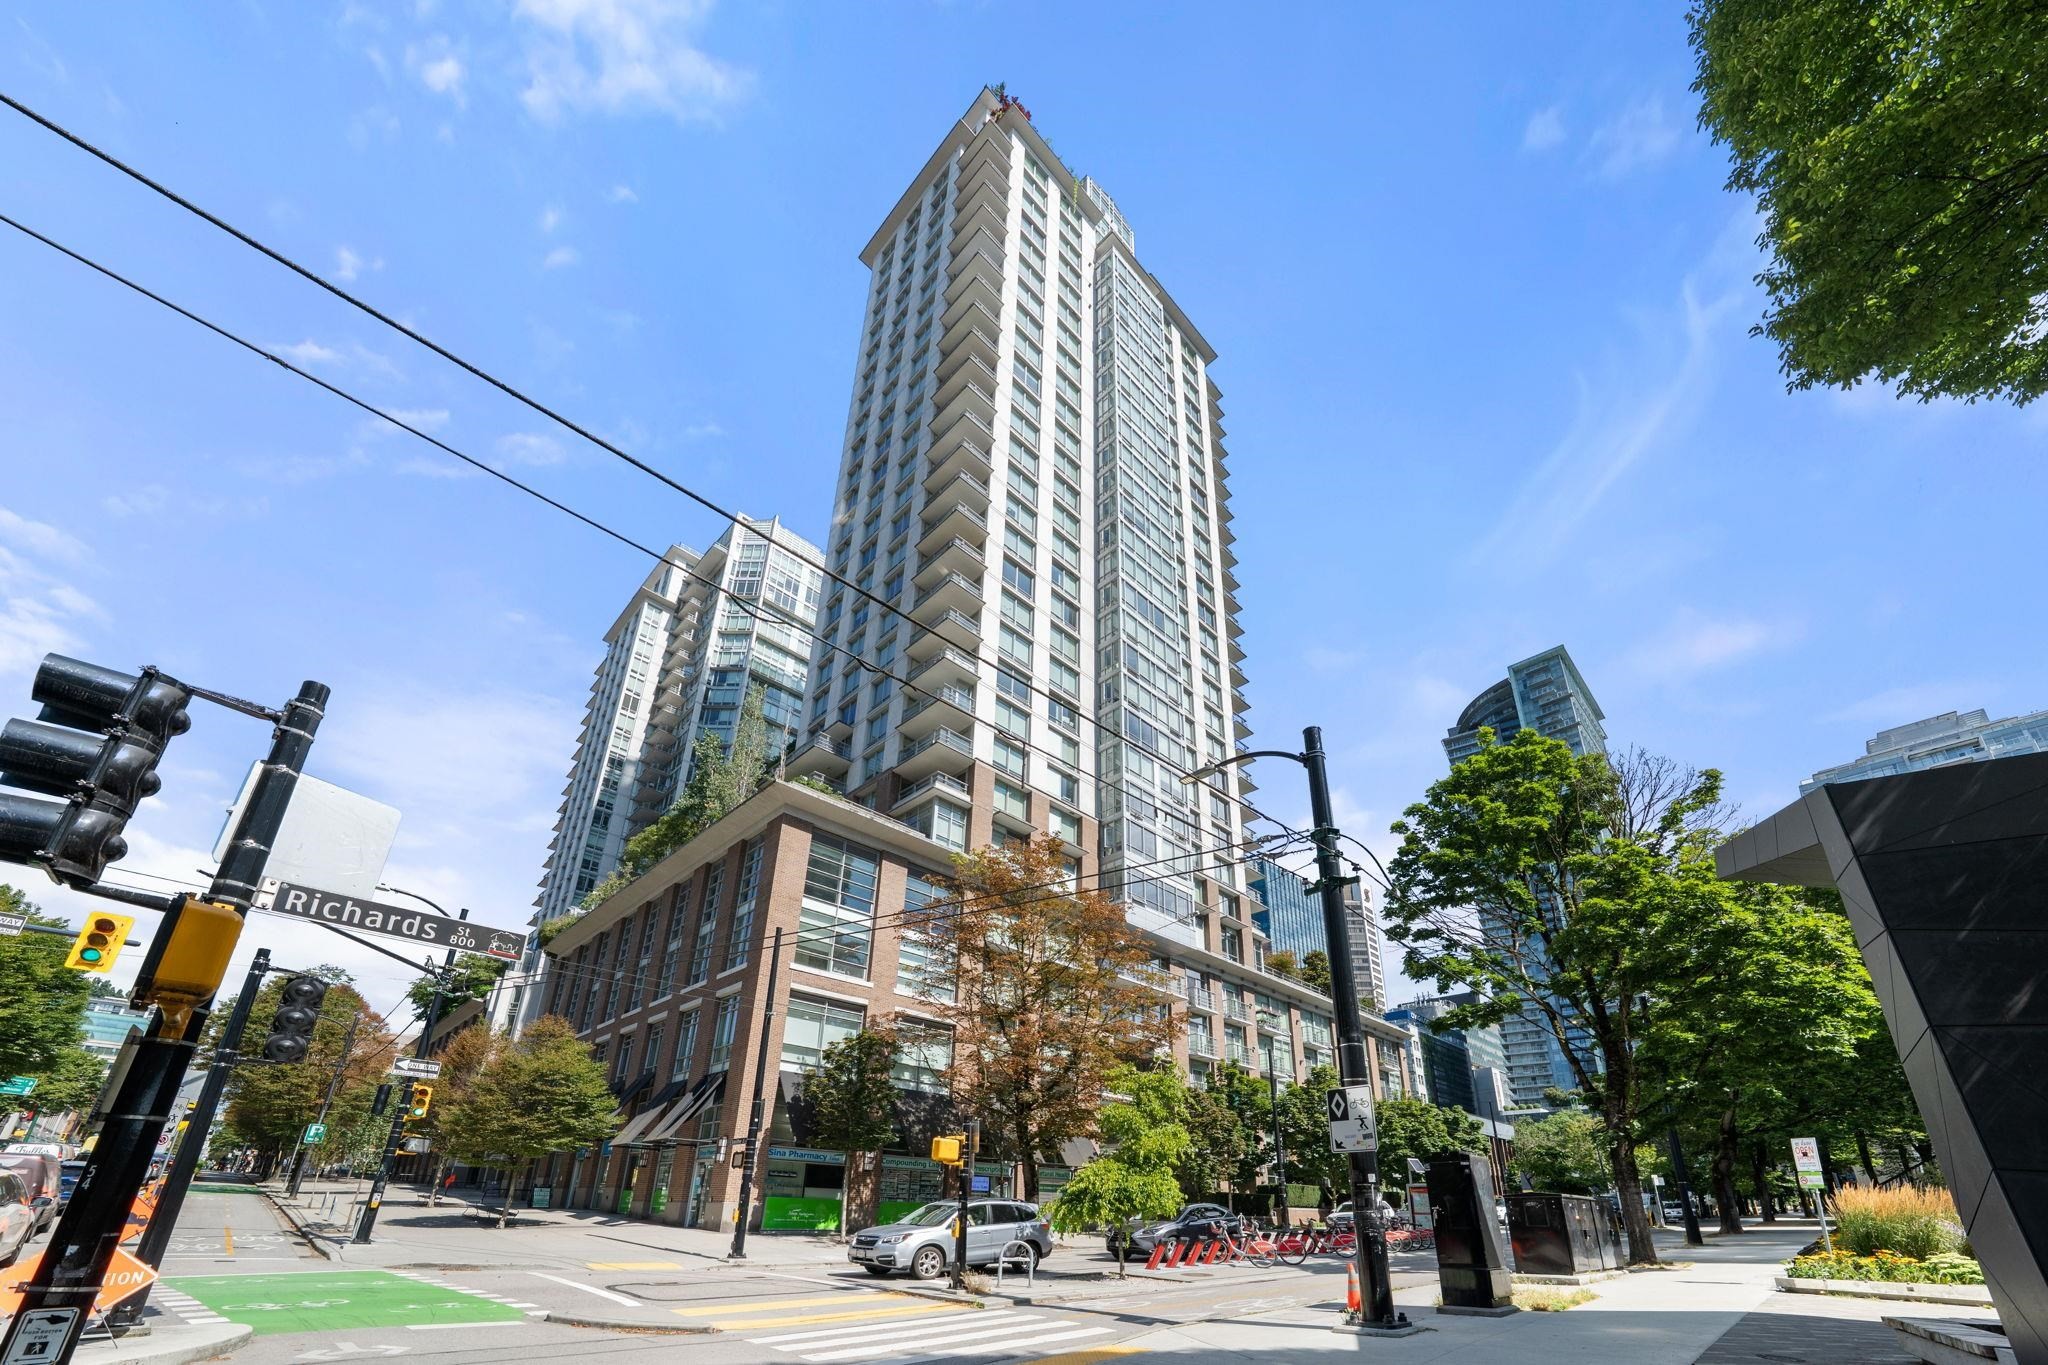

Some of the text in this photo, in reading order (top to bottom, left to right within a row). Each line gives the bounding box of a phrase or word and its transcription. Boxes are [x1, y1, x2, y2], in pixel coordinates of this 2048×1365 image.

[284, 890, 470, 939] Richards St
[449, 934, 475, 948] 800
[768, 1148, 787, 1157] Sina
[788, 1150, 828, 1161] Pharmacy
[882, 1159, 927, 1168] Compounding
